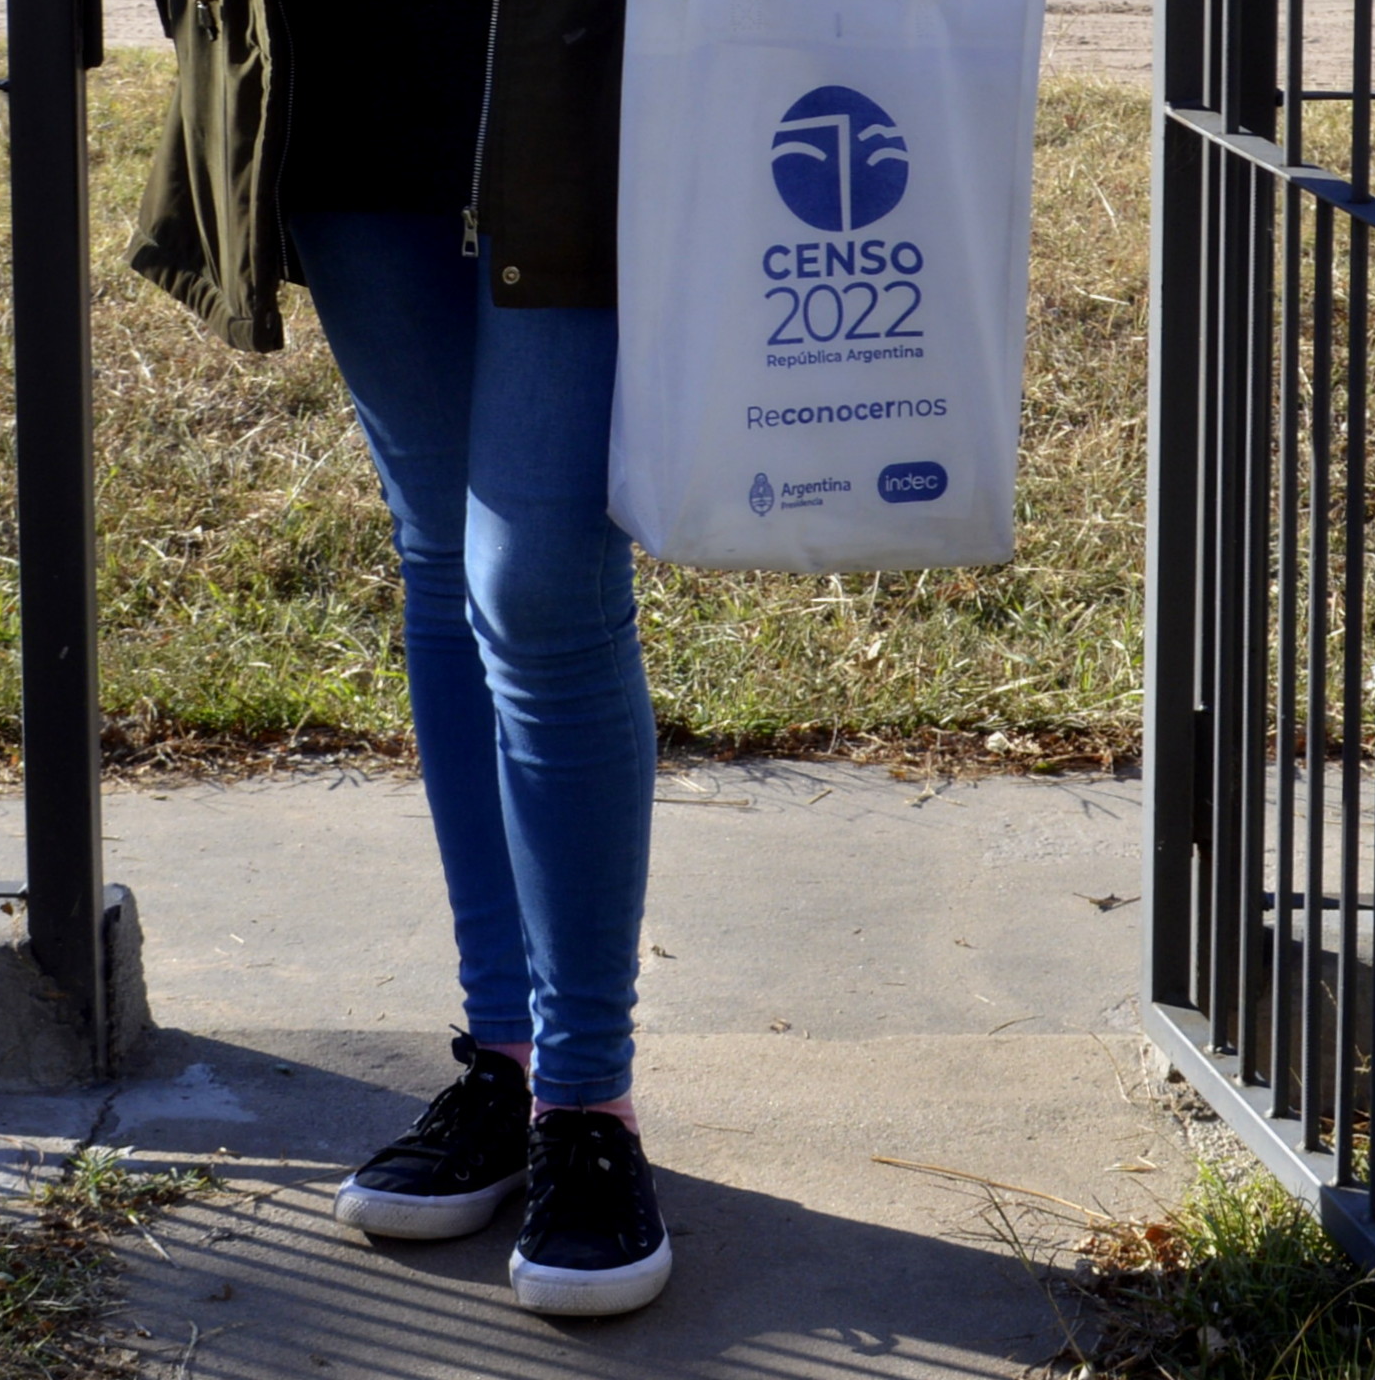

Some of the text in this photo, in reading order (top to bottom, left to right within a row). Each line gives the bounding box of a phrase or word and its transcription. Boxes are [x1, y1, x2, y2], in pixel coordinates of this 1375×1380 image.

[762, 240, 924, 280] CENSO
[764, 280, 924, 346] 2022
[767, 345, 924, 369] República Argentina
[747, 398, 947, 429] Reconocernos
[781, 477, 851, 499] Argentina
[885, 473, 938, 492] indec
[781, 497, 823, 510] Presidencia
